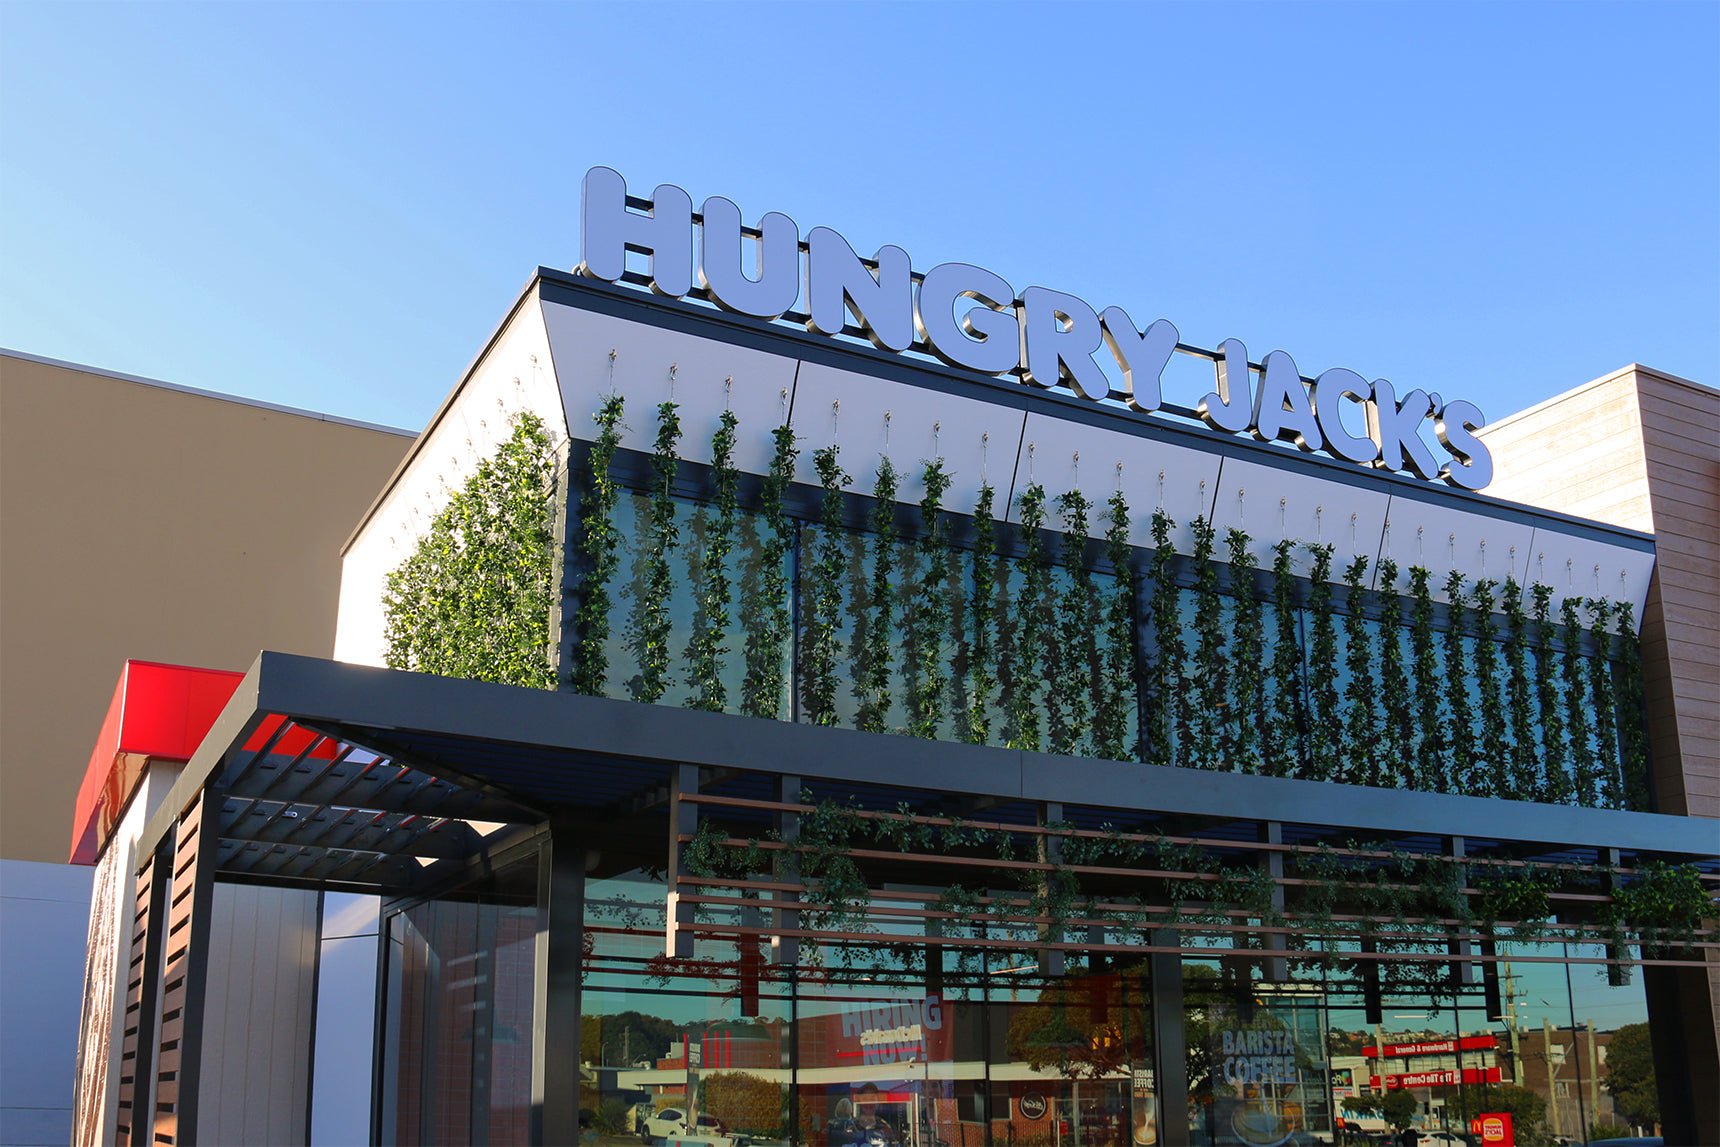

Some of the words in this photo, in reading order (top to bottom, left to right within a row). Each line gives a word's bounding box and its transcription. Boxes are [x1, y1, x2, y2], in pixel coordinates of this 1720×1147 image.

[582, 166, 1180, 411] HUNGRY
[1198, 338, 1494, 490] JACK'S
[840, 995, 942, 1038] HIRING
[863, 1034, 928, 1066] NOW!
[1222, 1030, 1295, 1055] BARISTA
[1224, 1055, 1297, 1086] COFFEE
